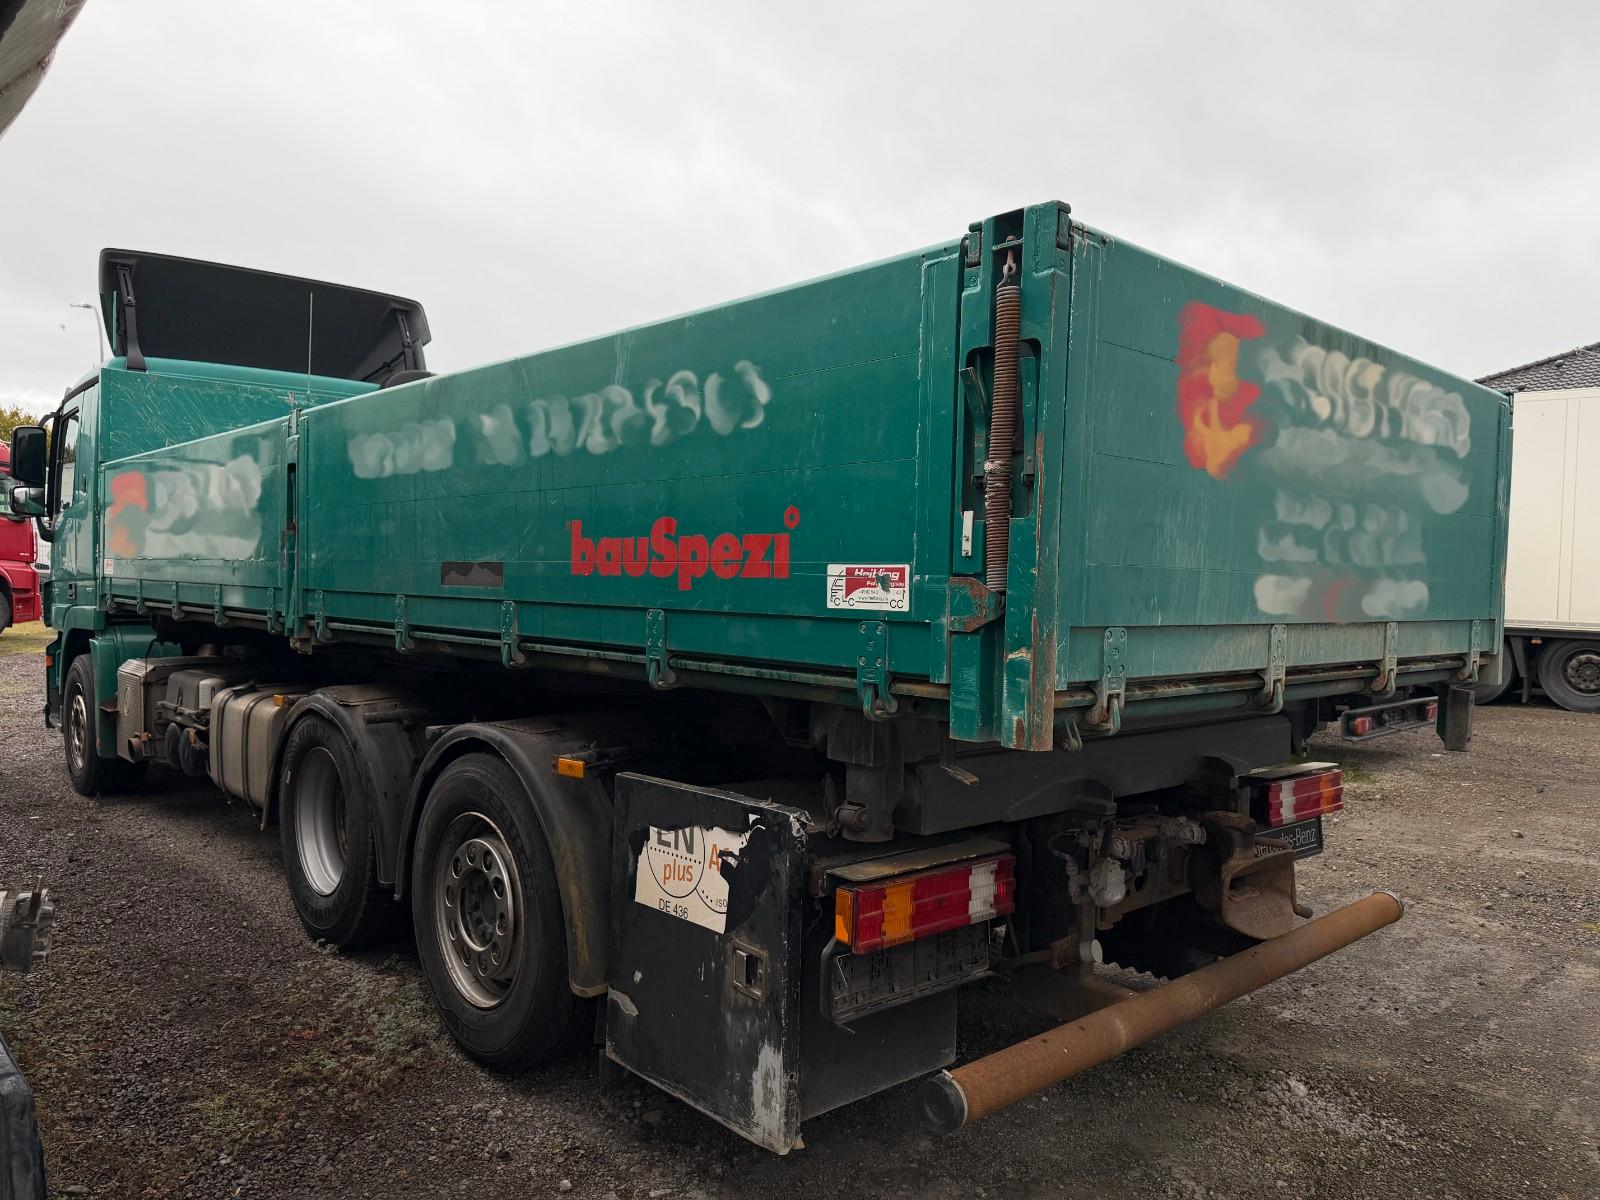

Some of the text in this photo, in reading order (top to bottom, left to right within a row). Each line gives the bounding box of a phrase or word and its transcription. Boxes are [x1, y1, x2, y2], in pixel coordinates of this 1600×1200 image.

[570, 505, 800, 591] bauSpezi
[663, 859, 694, 886] plus
[658, 898, 689, 920] DE 436
